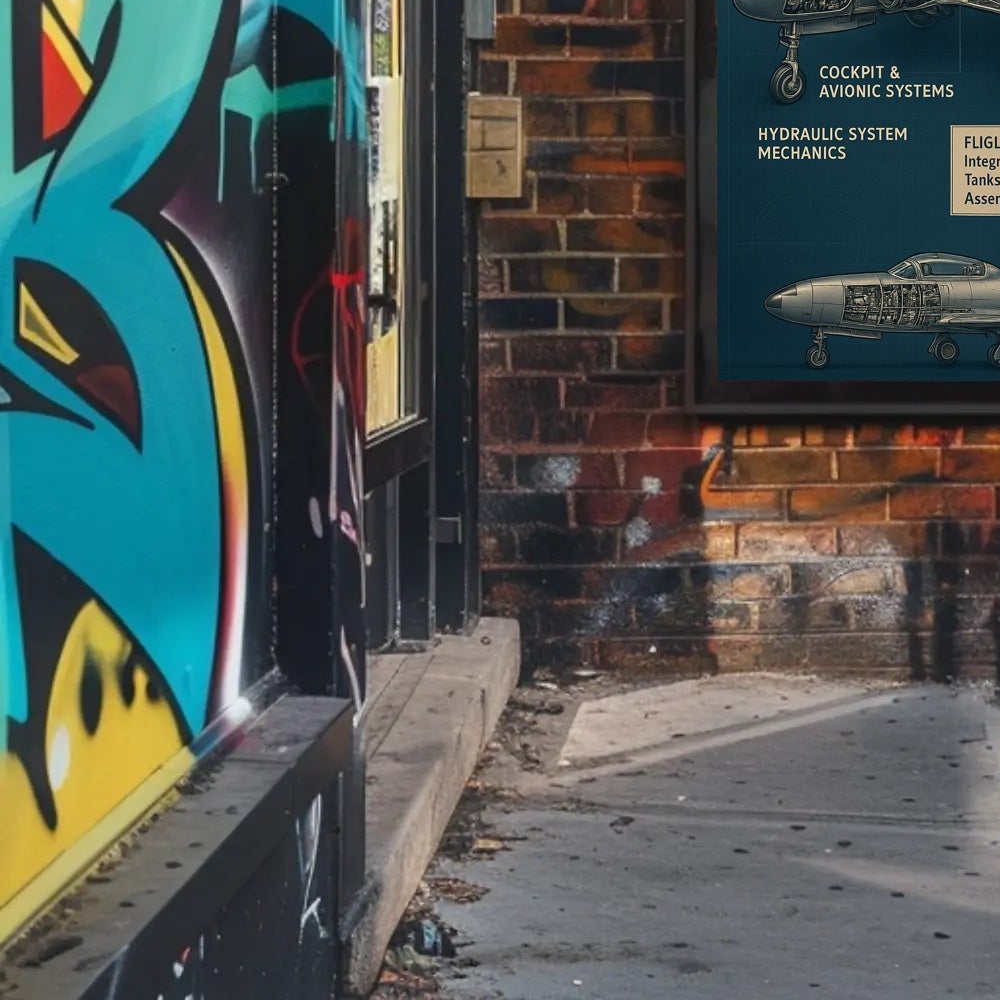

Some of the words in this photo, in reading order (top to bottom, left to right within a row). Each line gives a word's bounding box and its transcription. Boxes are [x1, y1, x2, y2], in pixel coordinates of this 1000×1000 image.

[819, 65, 885, 79] COCKPIT
[889, 65, 901, 80] &
[818, 84, 881, 98] AVIONIC
[885, 84, 954, 98] SYSTEMS
[758, 127, 844, 141] HYDRAULIC
[848, 127, 908, 141] SYSTEM
[758, 145, 847, 160] MECHANICS
[964, 172, 1000, 187] Tanks
